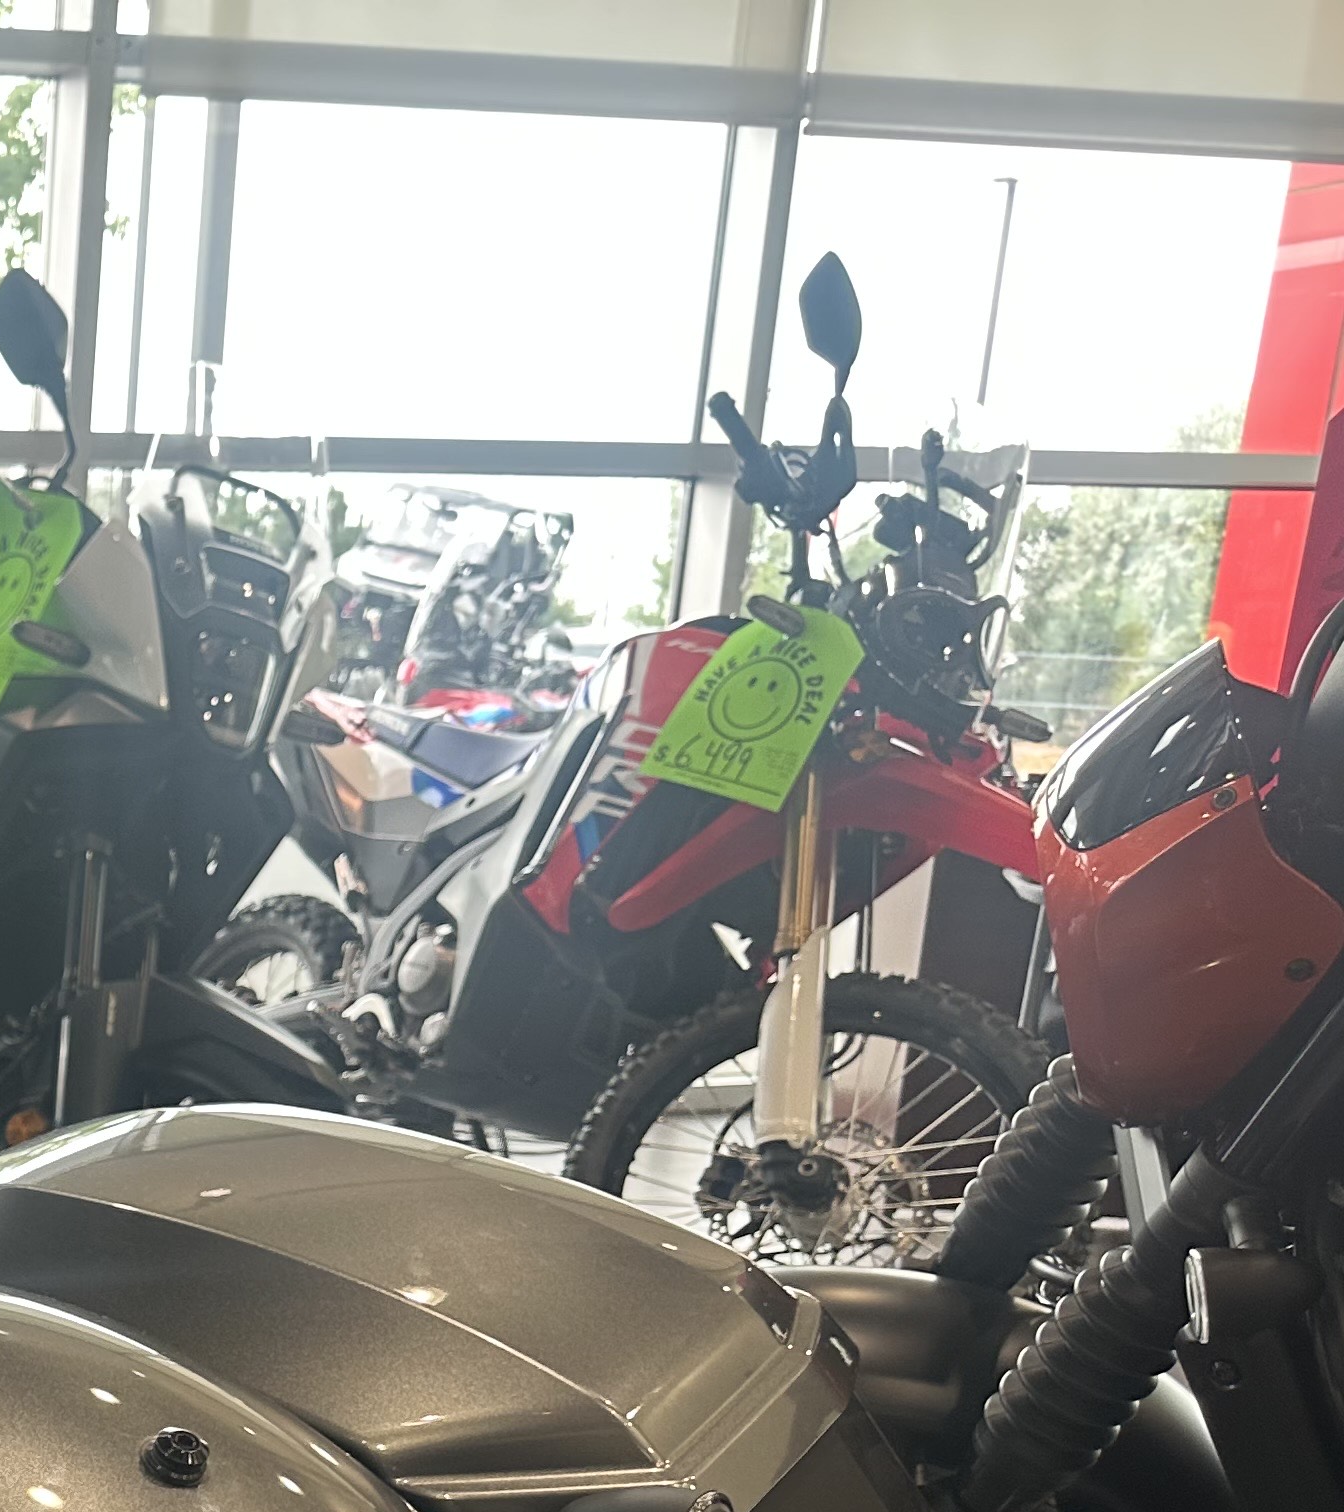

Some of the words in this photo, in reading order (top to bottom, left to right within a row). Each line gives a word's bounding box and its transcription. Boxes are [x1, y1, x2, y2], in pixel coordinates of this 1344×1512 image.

[694, 655, 739, 702] HAVE
[747, 645, 763, 659] A
[769, 640, 818, 669] NICE
[794, 673, 824, 725] DEAL
